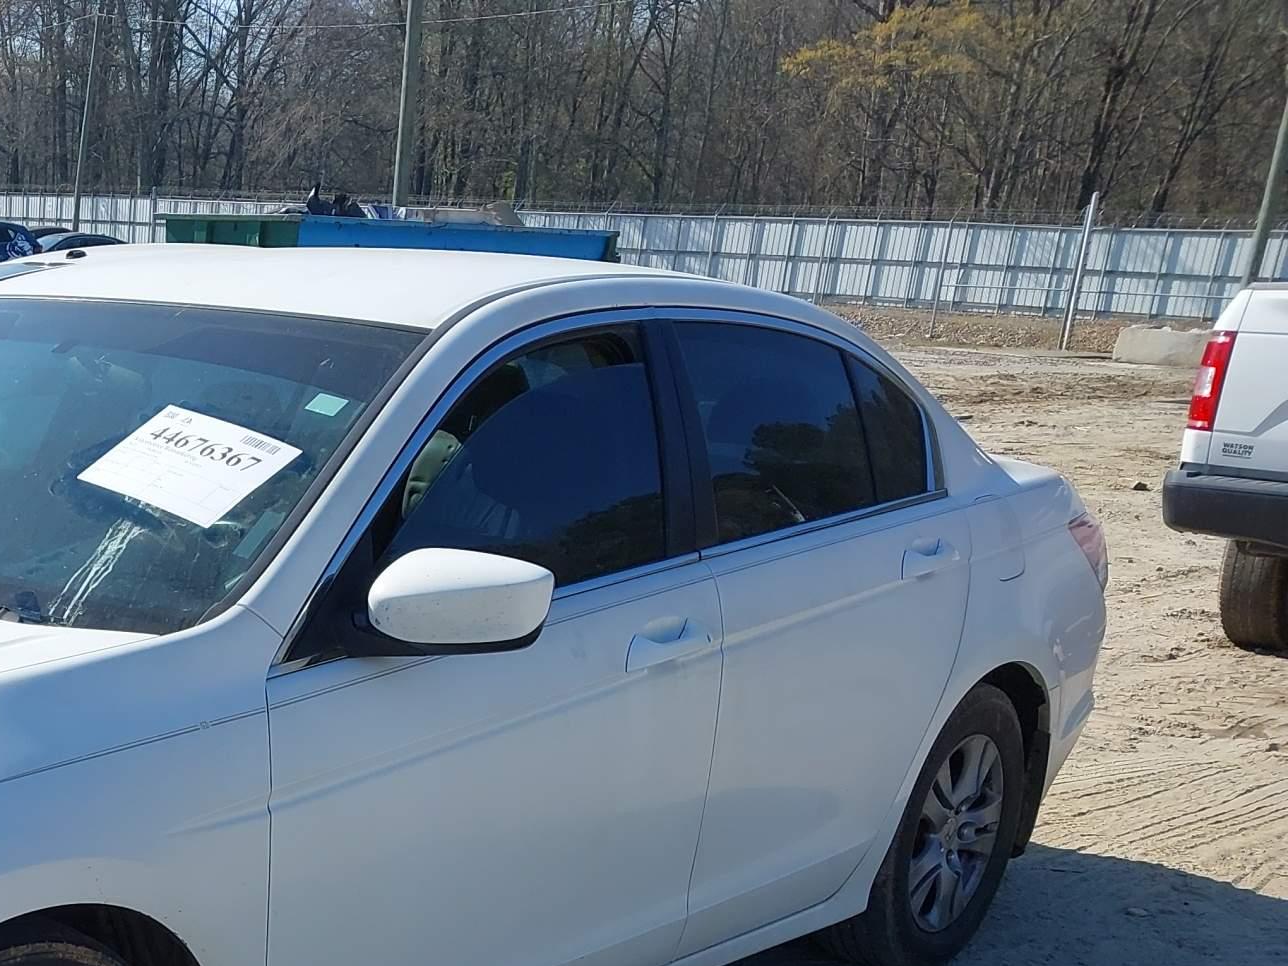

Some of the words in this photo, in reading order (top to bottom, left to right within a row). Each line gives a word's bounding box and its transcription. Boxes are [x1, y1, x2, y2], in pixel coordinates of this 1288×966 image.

[150, 426, 263, 472] 44676367
[1223, 442, 1254, 450] WATSON
[1222, 447, 1252, 456] QUALITY
